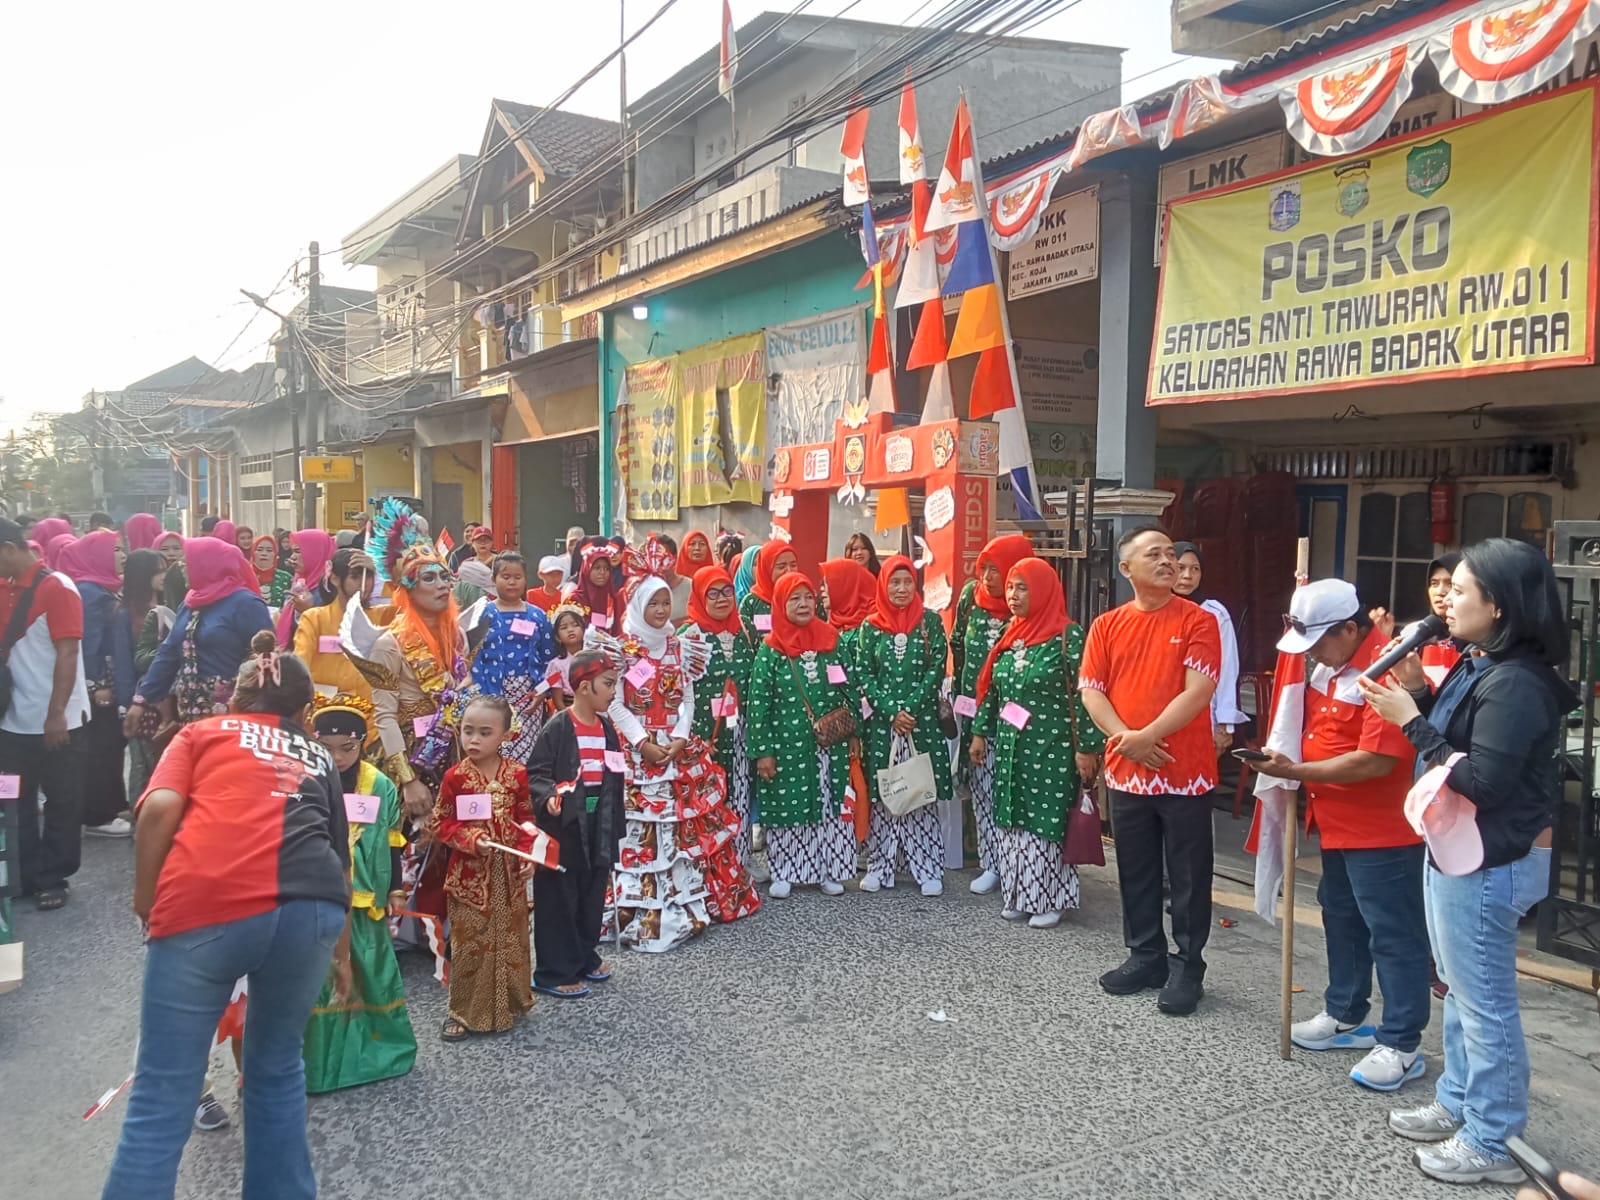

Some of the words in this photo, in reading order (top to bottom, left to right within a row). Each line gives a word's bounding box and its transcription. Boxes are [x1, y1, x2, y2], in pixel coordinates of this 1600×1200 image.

[1188, 154, 1248, 193] LMK
[1036, 209, 1067, 234] PKK
[1035, 237, 1048, 250] RW
[1051, 232, 1067, 245] 011
[1261, 206, 1451, 301] POSKO
[1026, 256, 1045, 266] RAWA
[1046, 249, 1069, 262] BADAK
[1071, 242, 1094, 255] UTARA
[1022, 276, 1052, 289] JAKARTA
[1055, 269, 1078, 281] UTARA
[1029, 266, 1047, 276] KOJA
[1163, 317, 1250, 355] SATGAS
[1259, 305, 1313, 344] ANTI
[1322, 281, 1448, 335] TAWURAN
[1159, 351, 1288, 394] KELURAHAN
[1295, 341, 1362, 382] RAWA
[1371, 327, 1462, 373] BADAK
[1471, 312, 1570, 361] UTARA
[221, 719, 333, 771] CHICAGO
[239, 731, 327, 777] BULLS
[356, 802, 367, 815] 3
[468, 801, 478, 815] 8
